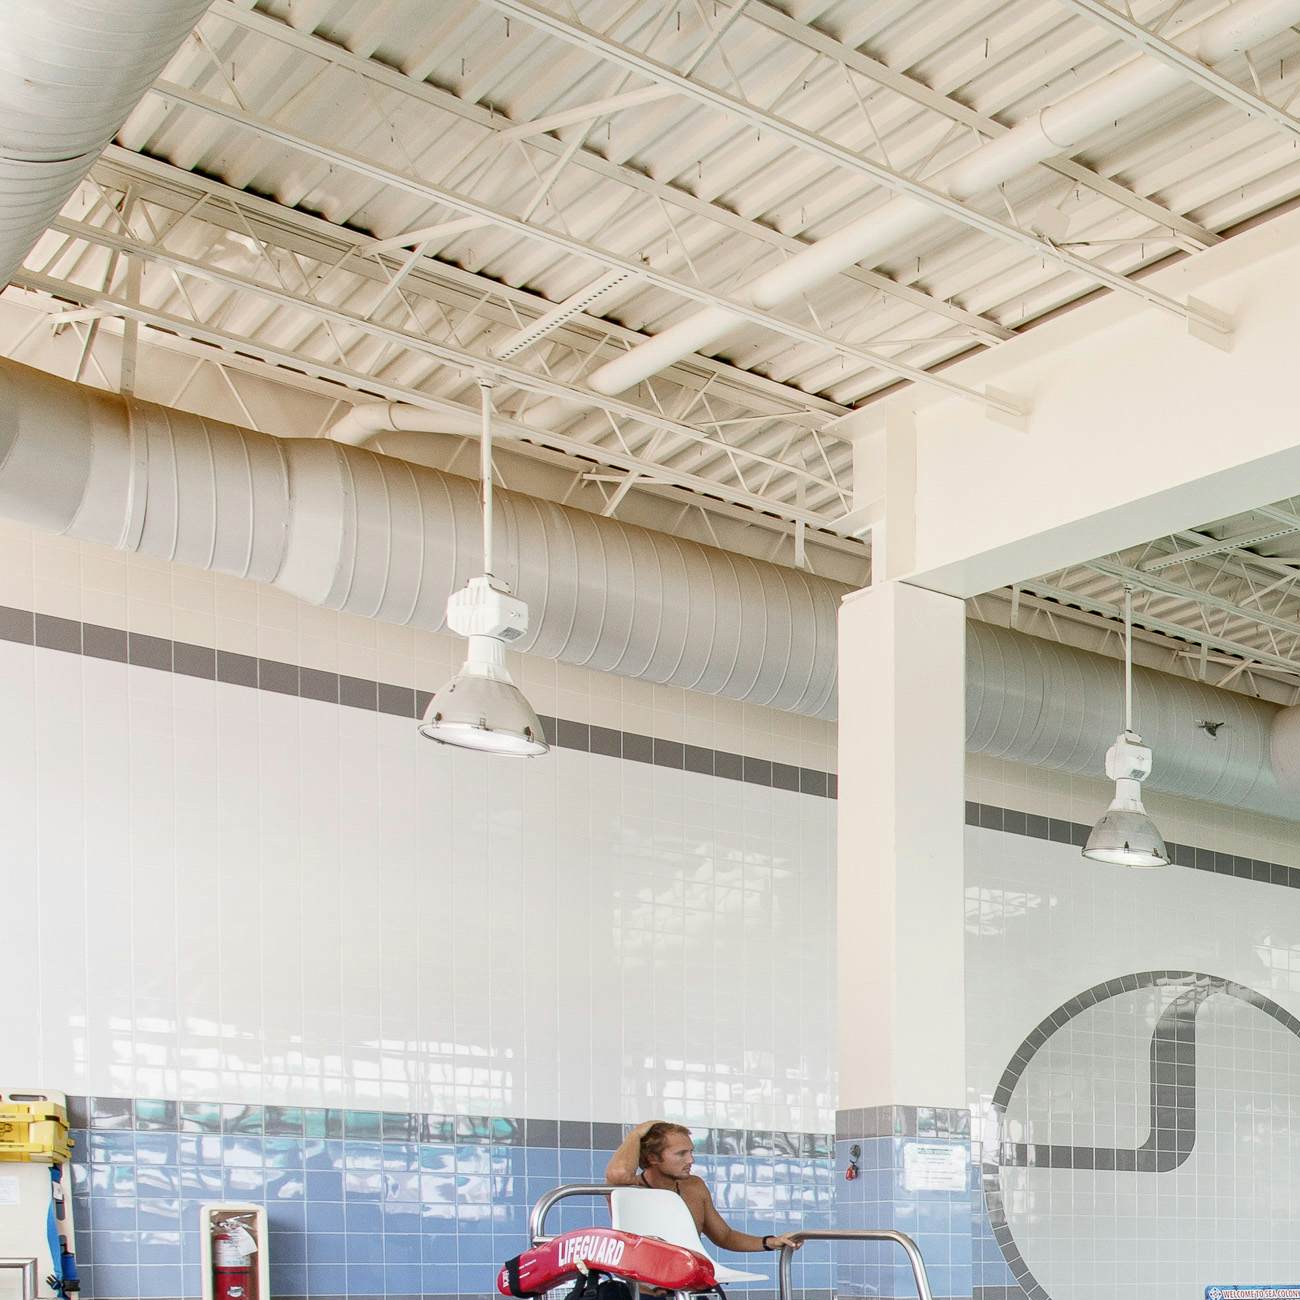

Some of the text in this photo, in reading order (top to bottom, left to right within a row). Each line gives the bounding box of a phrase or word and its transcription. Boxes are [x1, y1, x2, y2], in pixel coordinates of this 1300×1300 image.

[558, 1236, 624, 1267] LIFEGUARD
[1223, 1289, 1300, 1298] WELCOME TO SEA COLONY
